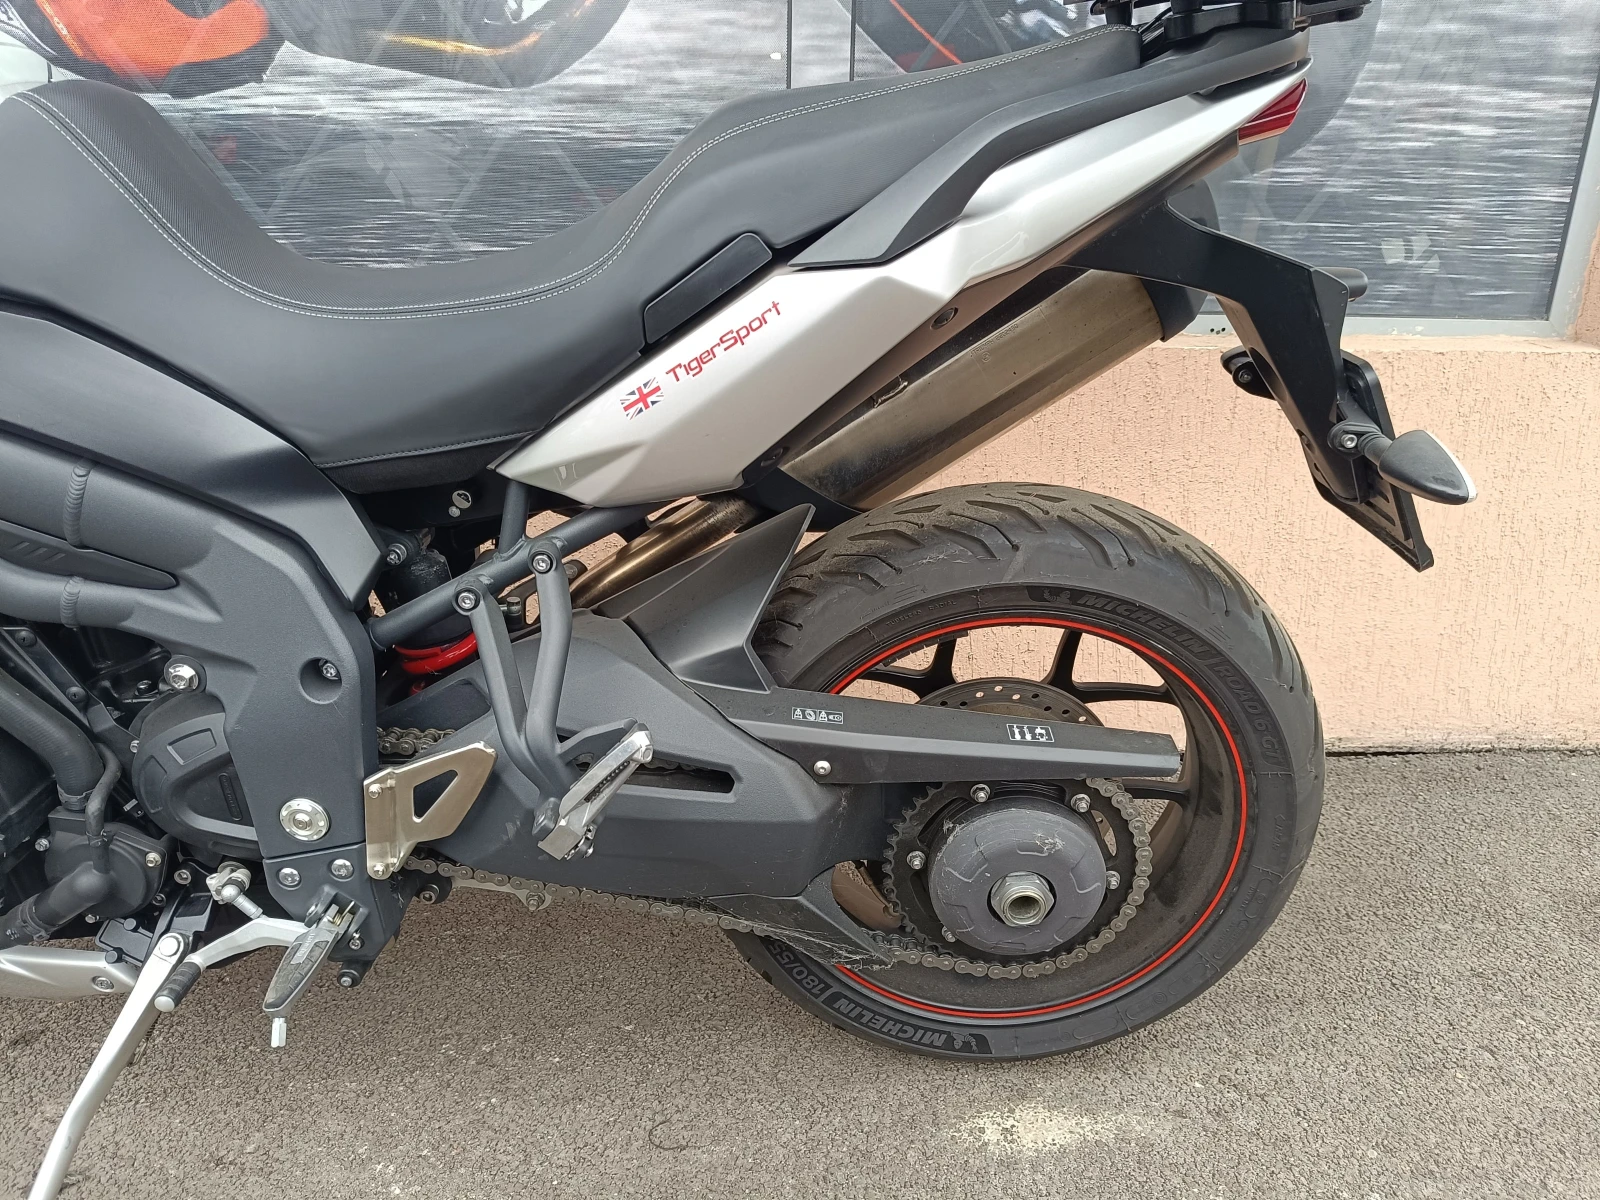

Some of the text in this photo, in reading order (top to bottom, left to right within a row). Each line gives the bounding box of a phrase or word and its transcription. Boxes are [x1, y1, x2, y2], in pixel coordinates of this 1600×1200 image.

[665, 301, 781, 382] TigerSport
[1077, 595, 1208, 655] MICHELIN
[1213, 663, 1262, 715] ROAD
[1253, 717, 1271, 733] 6
[767, 940, 825, 995] 180/55
[832, 998, 948, 1047] MICHELIN
